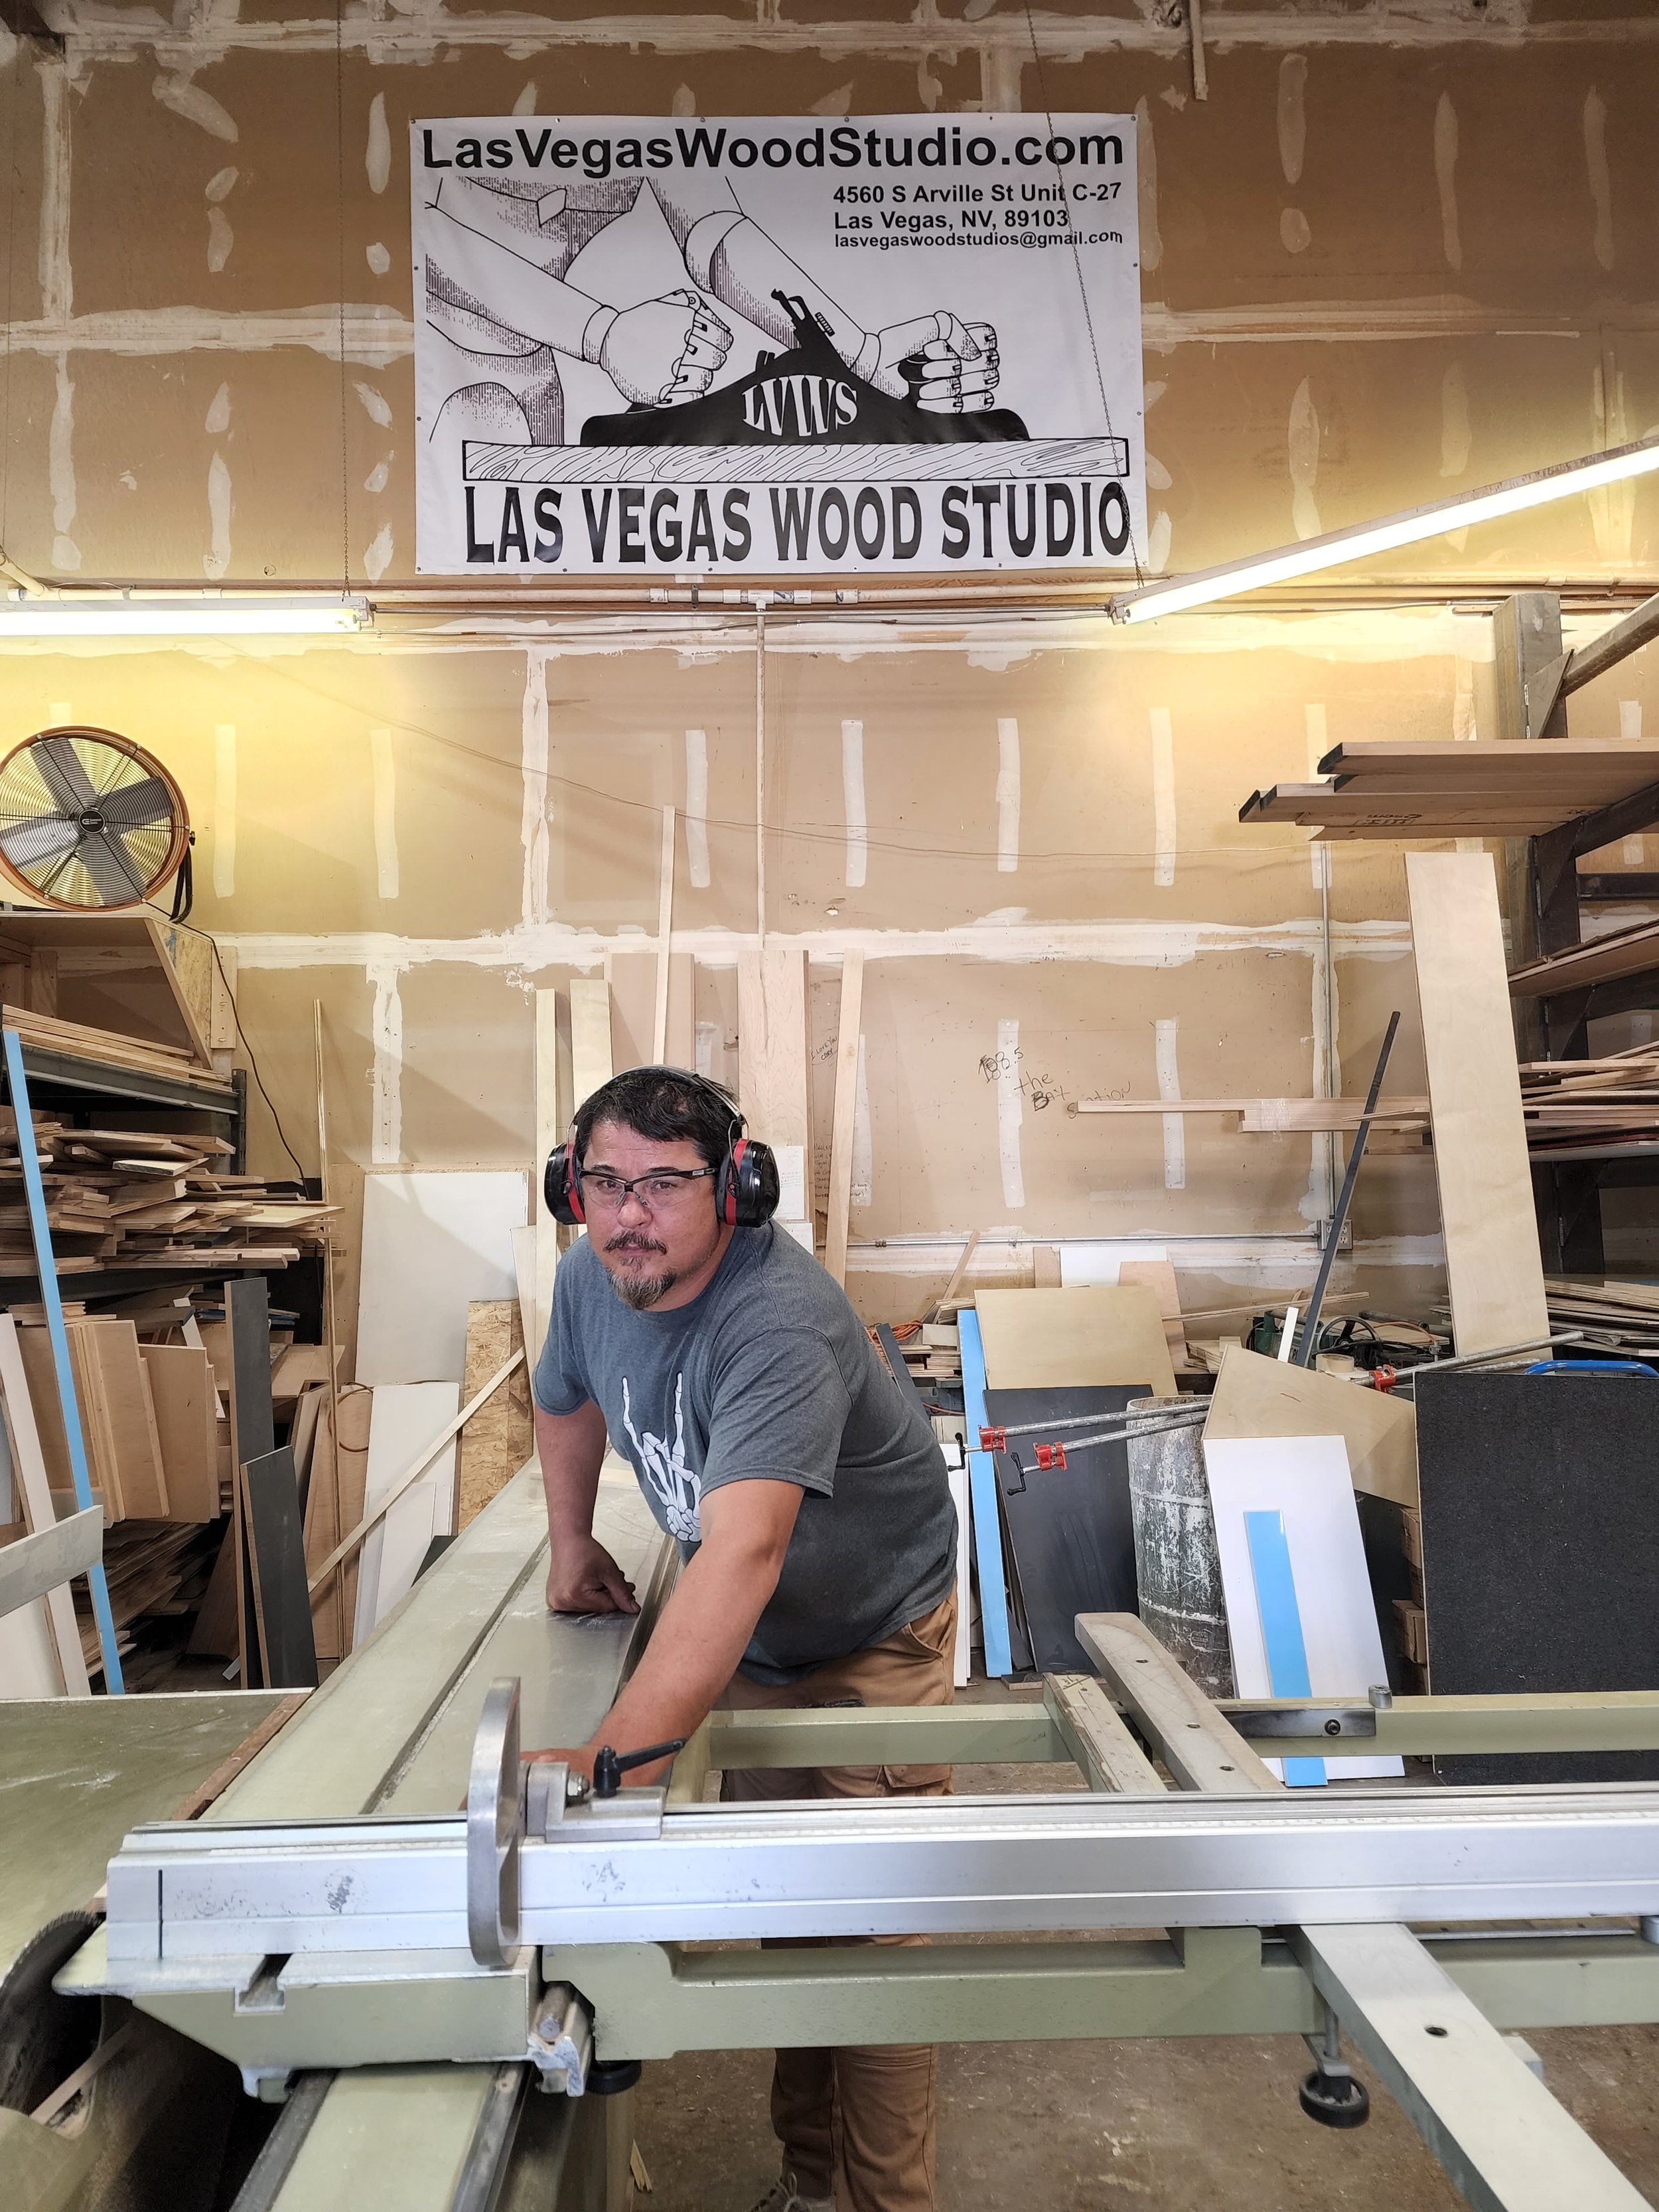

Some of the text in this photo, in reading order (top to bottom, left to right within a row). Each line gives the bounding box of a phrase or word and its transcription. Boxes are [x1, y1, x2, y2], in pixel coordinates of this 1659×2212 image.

[423, 127, 1123, 179] LasVegasWoodStudio.com
[833, 182, 1121, 203] 4560 S Arville St Unit C-27
[834, 209, 1068, 232] Las Vegas, NV, 89103
[835, 231, 1123, 250] lasvegaswoodstudios@gmail.com
[742, 374, 857, 437] LVWS
[464, 482, 1131, 565] LAS VEGAS WOOD STUDIO
